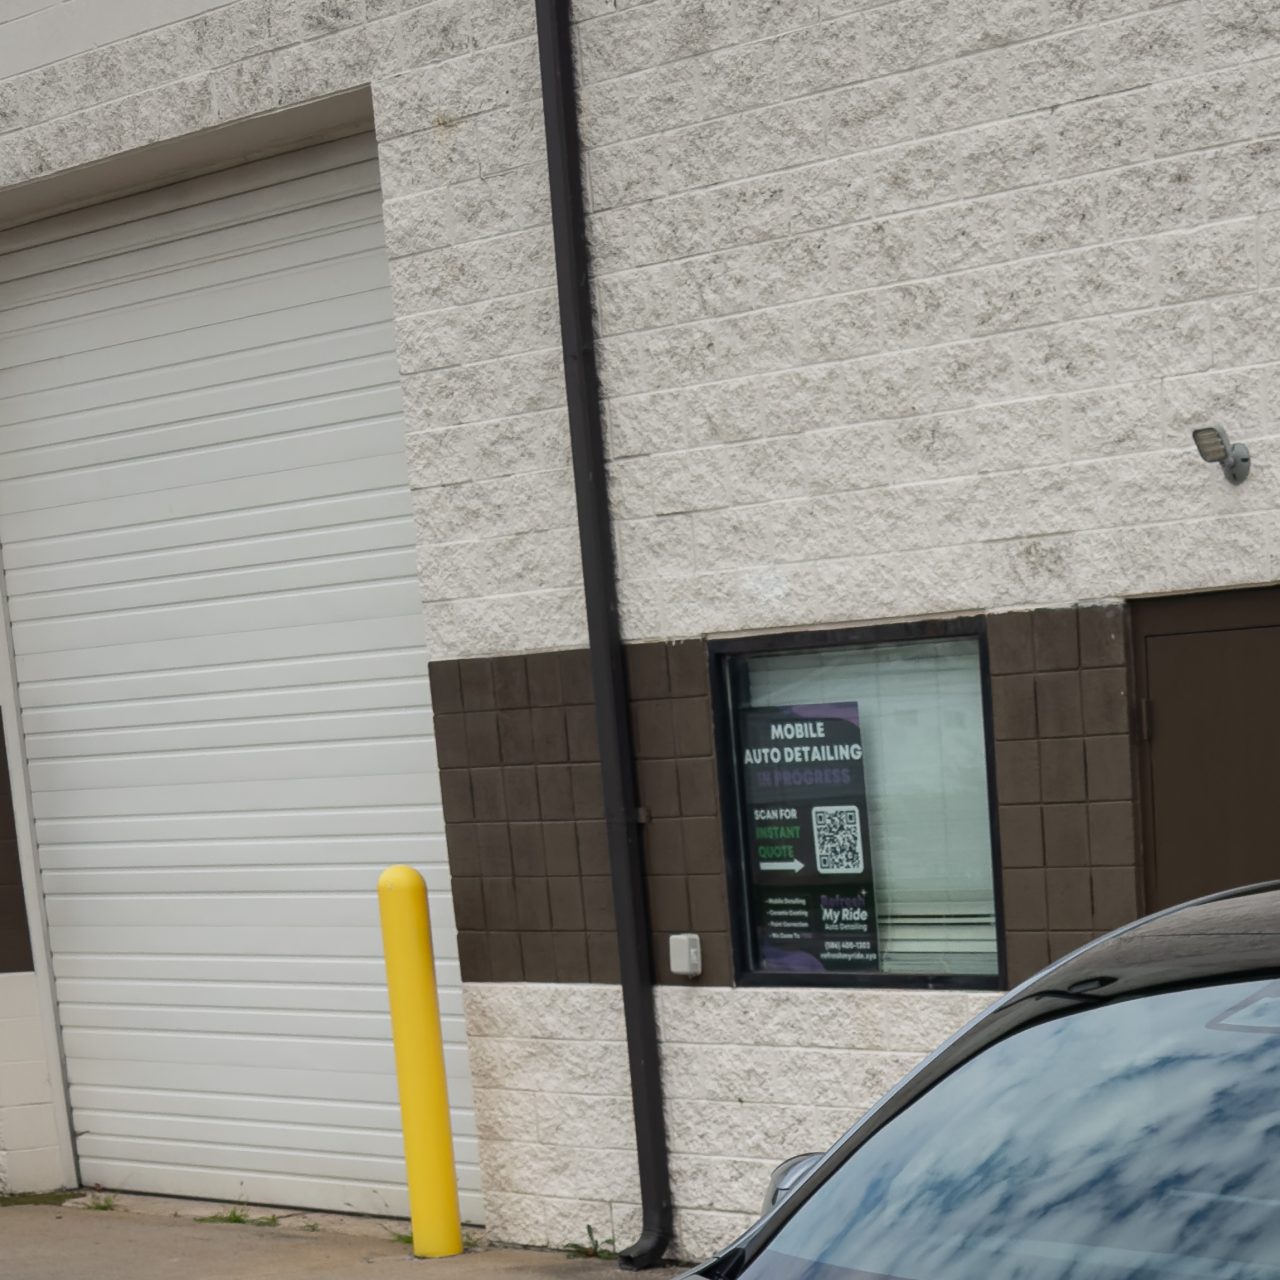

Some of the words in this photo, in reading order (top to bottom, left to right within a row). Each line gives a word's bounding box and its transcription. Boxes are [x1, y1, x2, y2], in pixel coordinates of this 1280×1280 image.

[770, 721, 825, 740] MOBILE
[743, 747, 781, 765] AUTO
[784, 743, 863, 763] DETAILING
[774, 768, 851, 786] PROGRESS
[753, 809, 779, 821] SCAN
[780, 808, 798, 820] FOR
[755, 825, 801, 839] INSTANT
[758, 844, 795, 859] QUOTE
[822, 908, 840, 924] My
[841, 907, 868, 921] Ride
